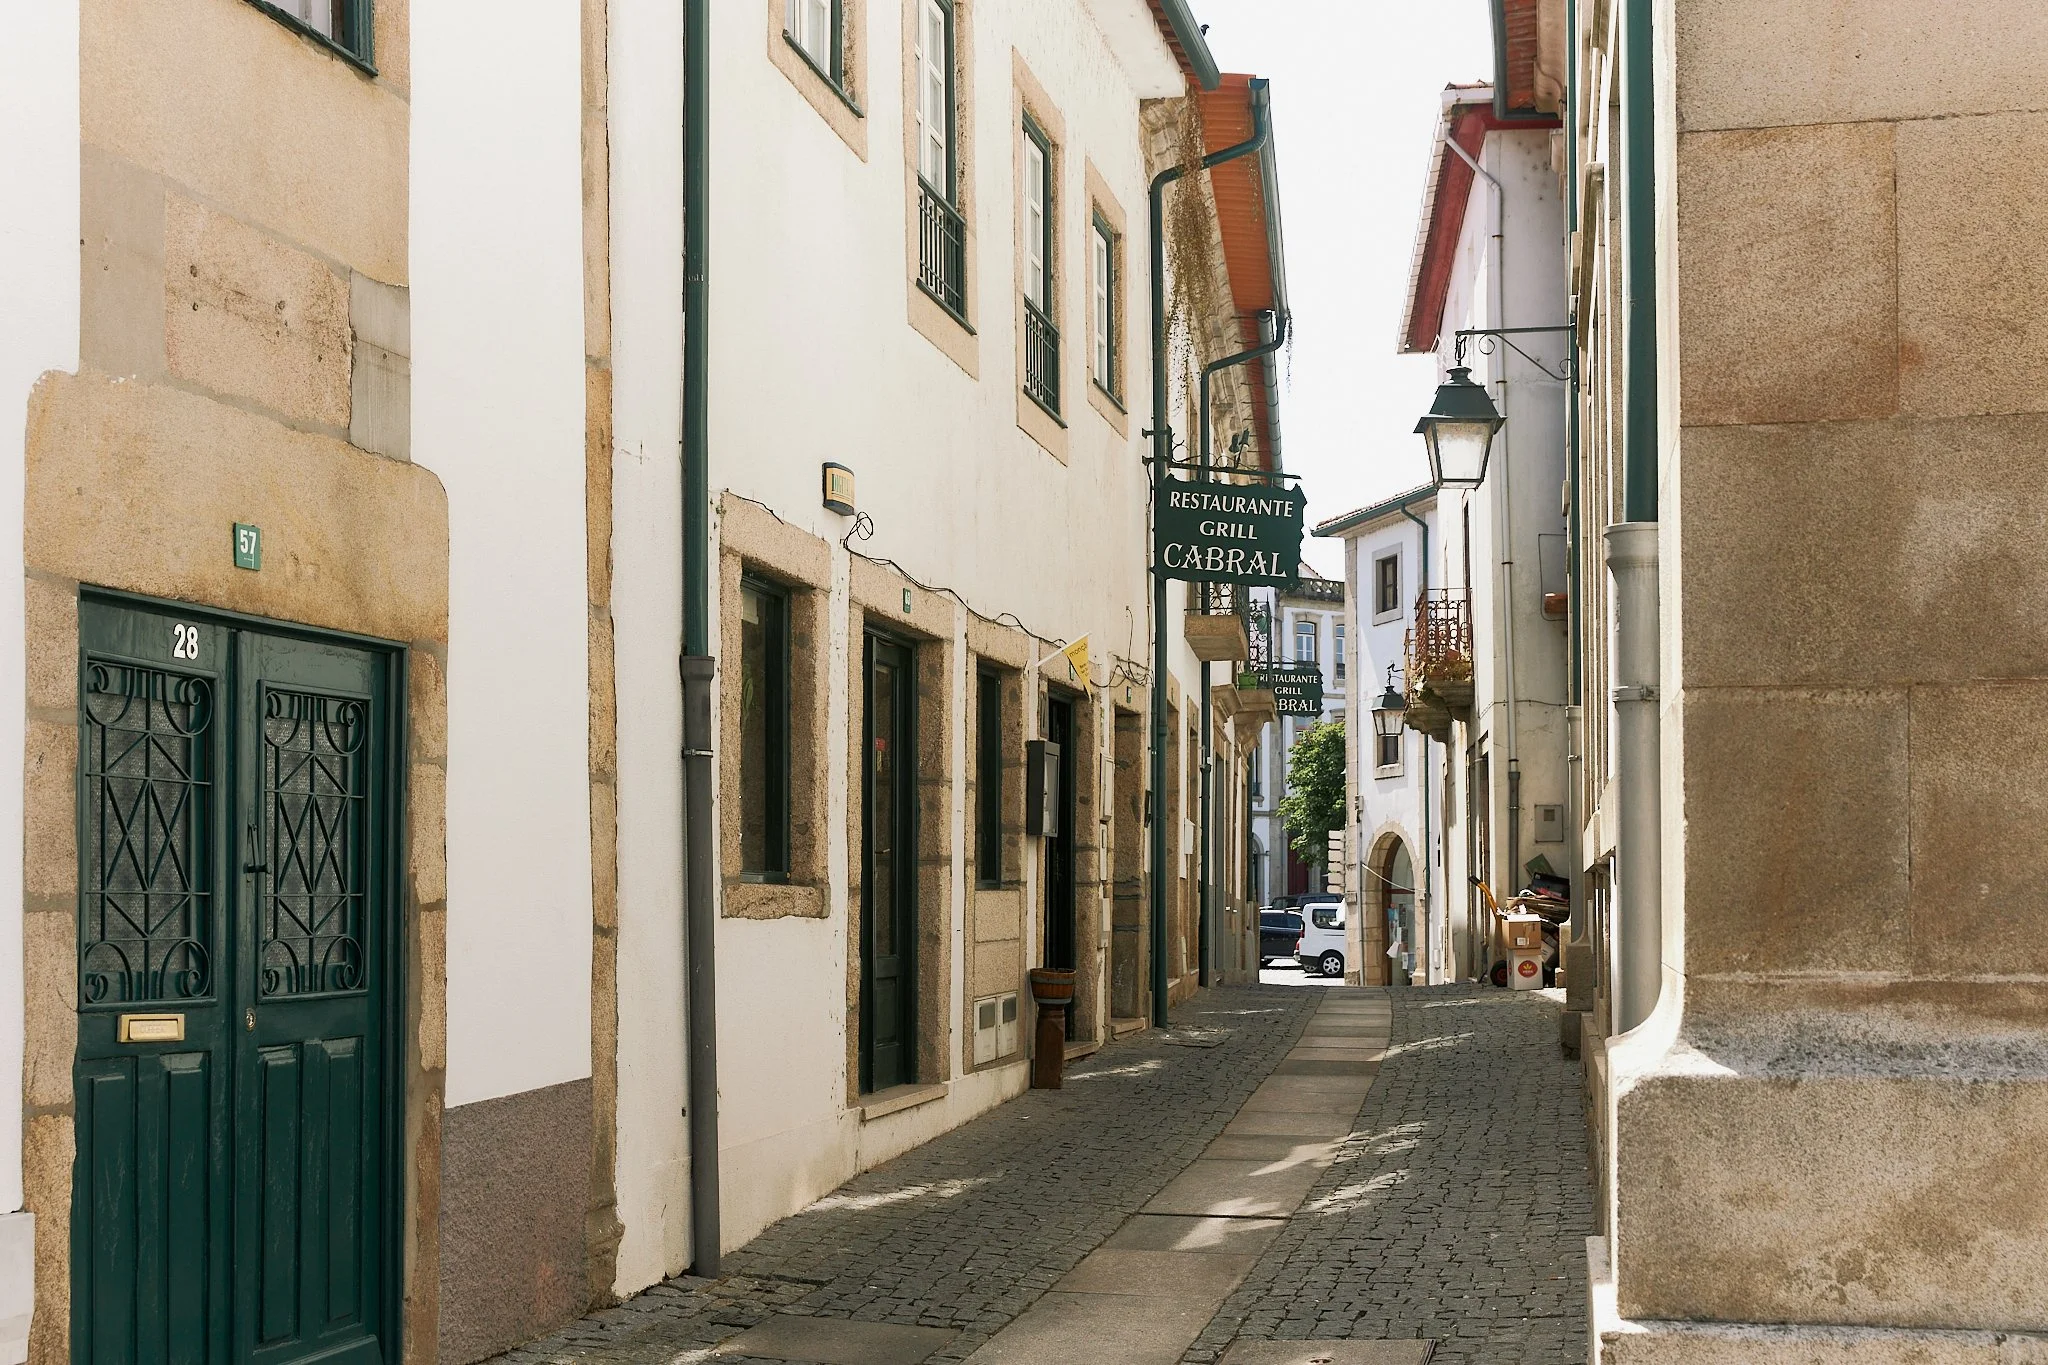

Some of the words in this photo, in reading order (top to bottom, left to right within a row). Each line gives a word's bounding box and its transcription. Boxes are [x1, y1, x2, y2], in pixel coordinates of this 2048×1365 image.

[1169, 491, 1294, 518] RESTAURANTE
[1199, 520, 1258, 540] GRILL
[240, 529, 257, 555] 57
[1163, 542, 1288, 578] CABRAL
[173, 623, 199, 660] 28
[1259, 673, 1318, 684] RTAURANTE
[1274, 686, 1303, 695] GRILL
[1275, 698, 1318, 712] BRAL
